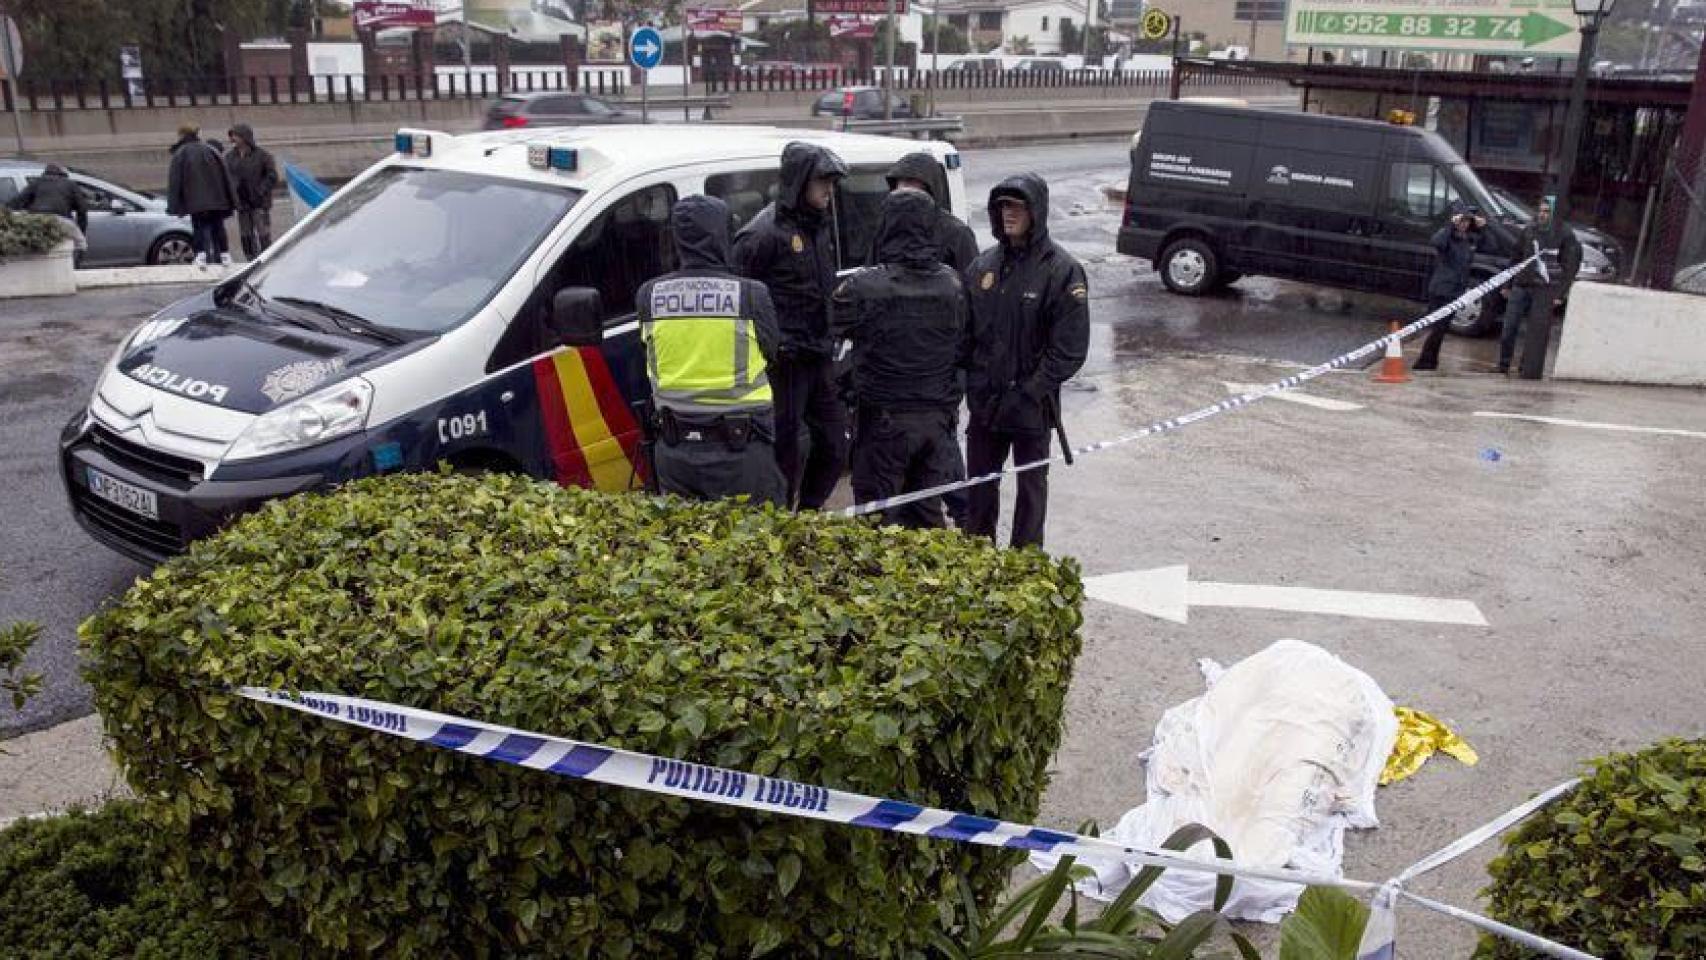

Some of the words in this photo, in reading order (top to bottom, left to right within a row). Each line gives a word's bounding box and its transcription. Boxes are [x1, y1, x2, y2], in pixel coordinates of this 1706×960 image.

[1343, 15, 1389, 34] 952
[1400, 15, 1432, 35] 88
[1444, 17, 1476, 36] 32
[1488, 17, 1523, 38] 74
[654, 293, 737, 313] POLICIA
[647, 756, 748, 798] POLICIA
[753, 776, 830, 812] LOCAL
